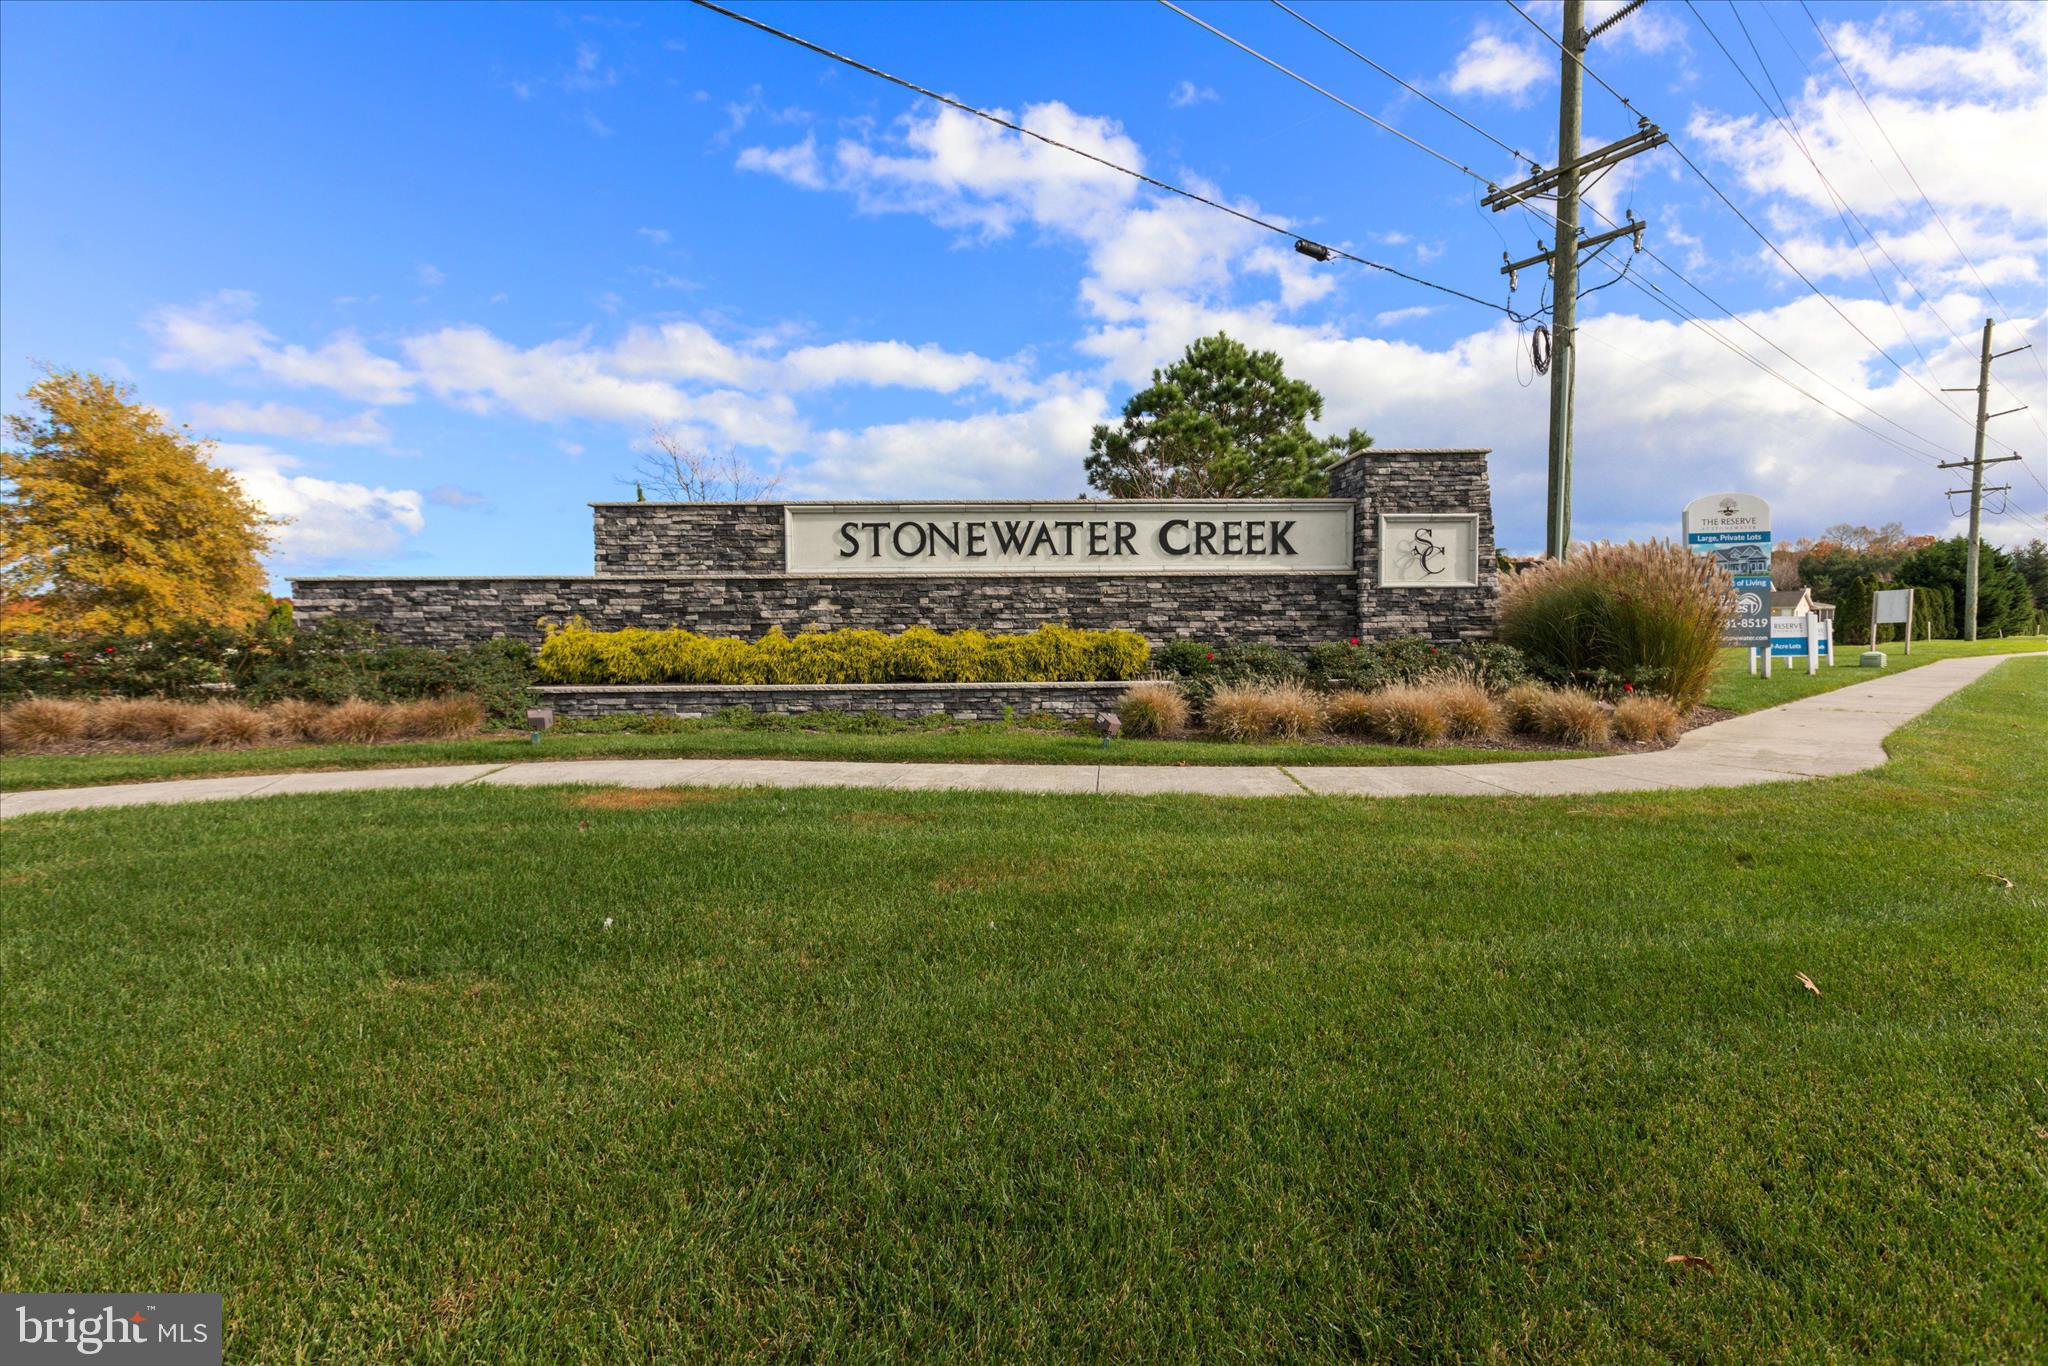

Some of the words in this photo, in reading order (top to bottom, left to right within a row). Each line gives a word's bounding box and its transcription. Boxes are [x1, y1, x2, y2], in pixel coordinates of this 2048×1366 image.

[1701, 518, 1719, 526] THE
[1720, 517, 1757, 526] RESERVE
[839, 520, 1140, 557] STONEWATER
[1158, 519, 1298, 556] CREEK
[1720, 533, 1746, 542] Private
[1746, 533, 1762, 541] Lots
[1736, 579, 1744, 587] of
[1745, 578, 1767, 588] Living
